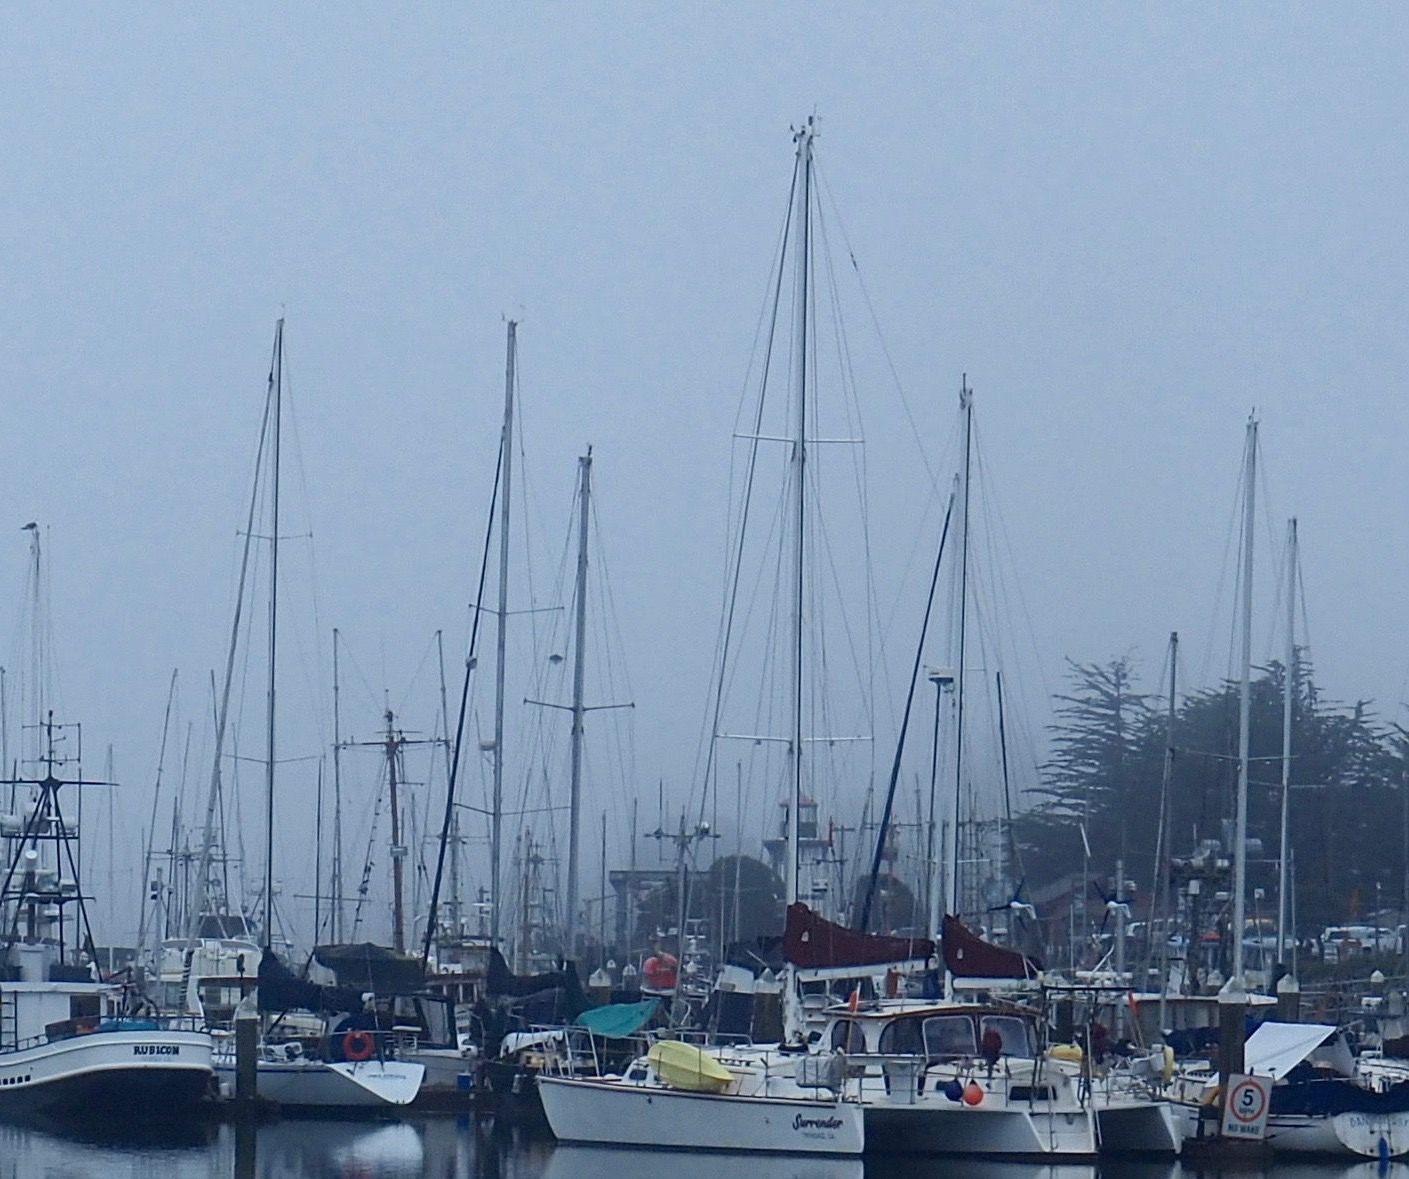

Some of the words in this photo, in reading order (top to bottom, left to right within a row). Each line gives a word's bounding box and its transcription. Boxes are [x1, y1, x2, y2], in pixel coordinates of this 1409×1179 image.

[134, 1045, 179, 1055] RUBICON
[1242, 1088, 1253, 1106] 5
[793, 1113, 843, 1130] Surrender
[1228, 1123, 1238, 1132] NO
[1240, 1124, 1260, 1134] WAKE
